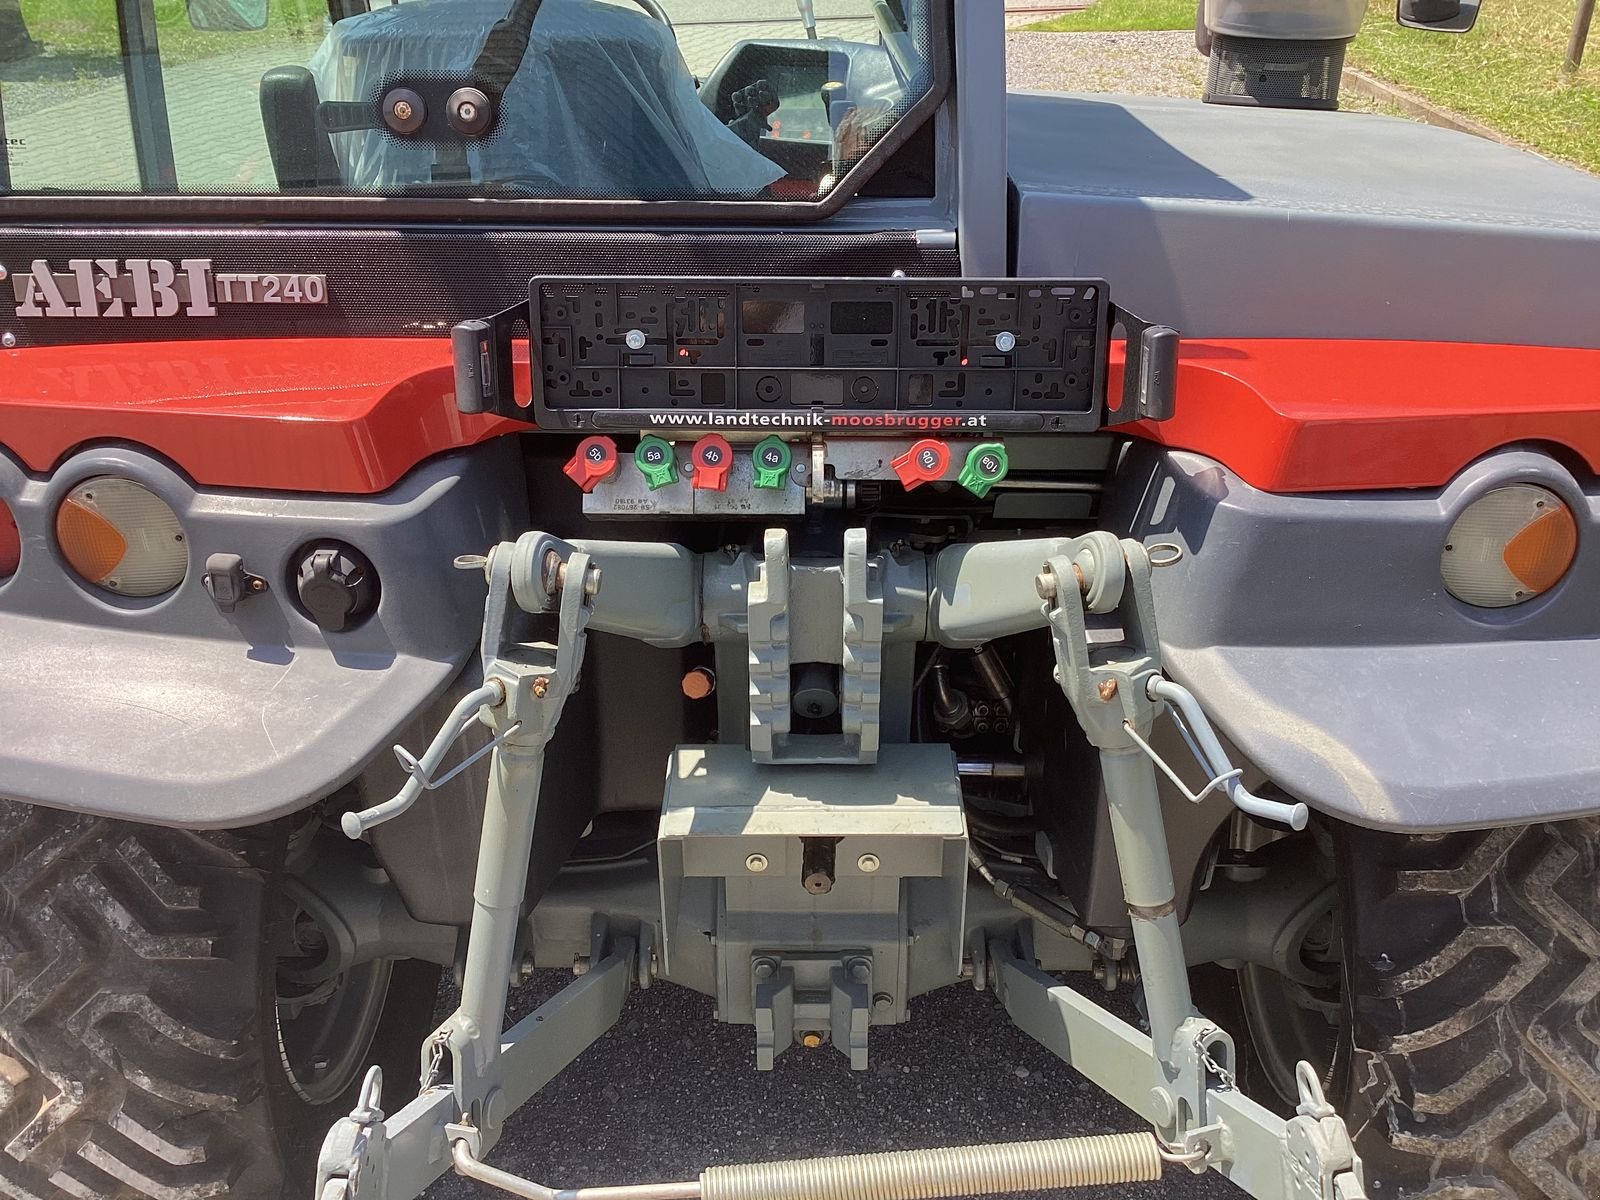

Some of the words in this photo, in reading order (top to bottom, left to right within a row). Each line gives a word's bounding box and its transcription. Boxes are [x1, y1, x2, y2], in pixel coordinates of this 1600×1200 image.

[16, 259, 217, 317] AEBI
[216, 274, 324, 303] TT240
[649, 412, 988, 429] www.landtechnik-moosbrugger.at
[589, 447, 602, 462] 5b
[647, 451, 661, 462] 5a
[705, 450, 719, 462] 4b
[764, 452, 779, 463] 4a
[922, 450, 936, 469] 10b
[982, 456, 998, 473] 10a
